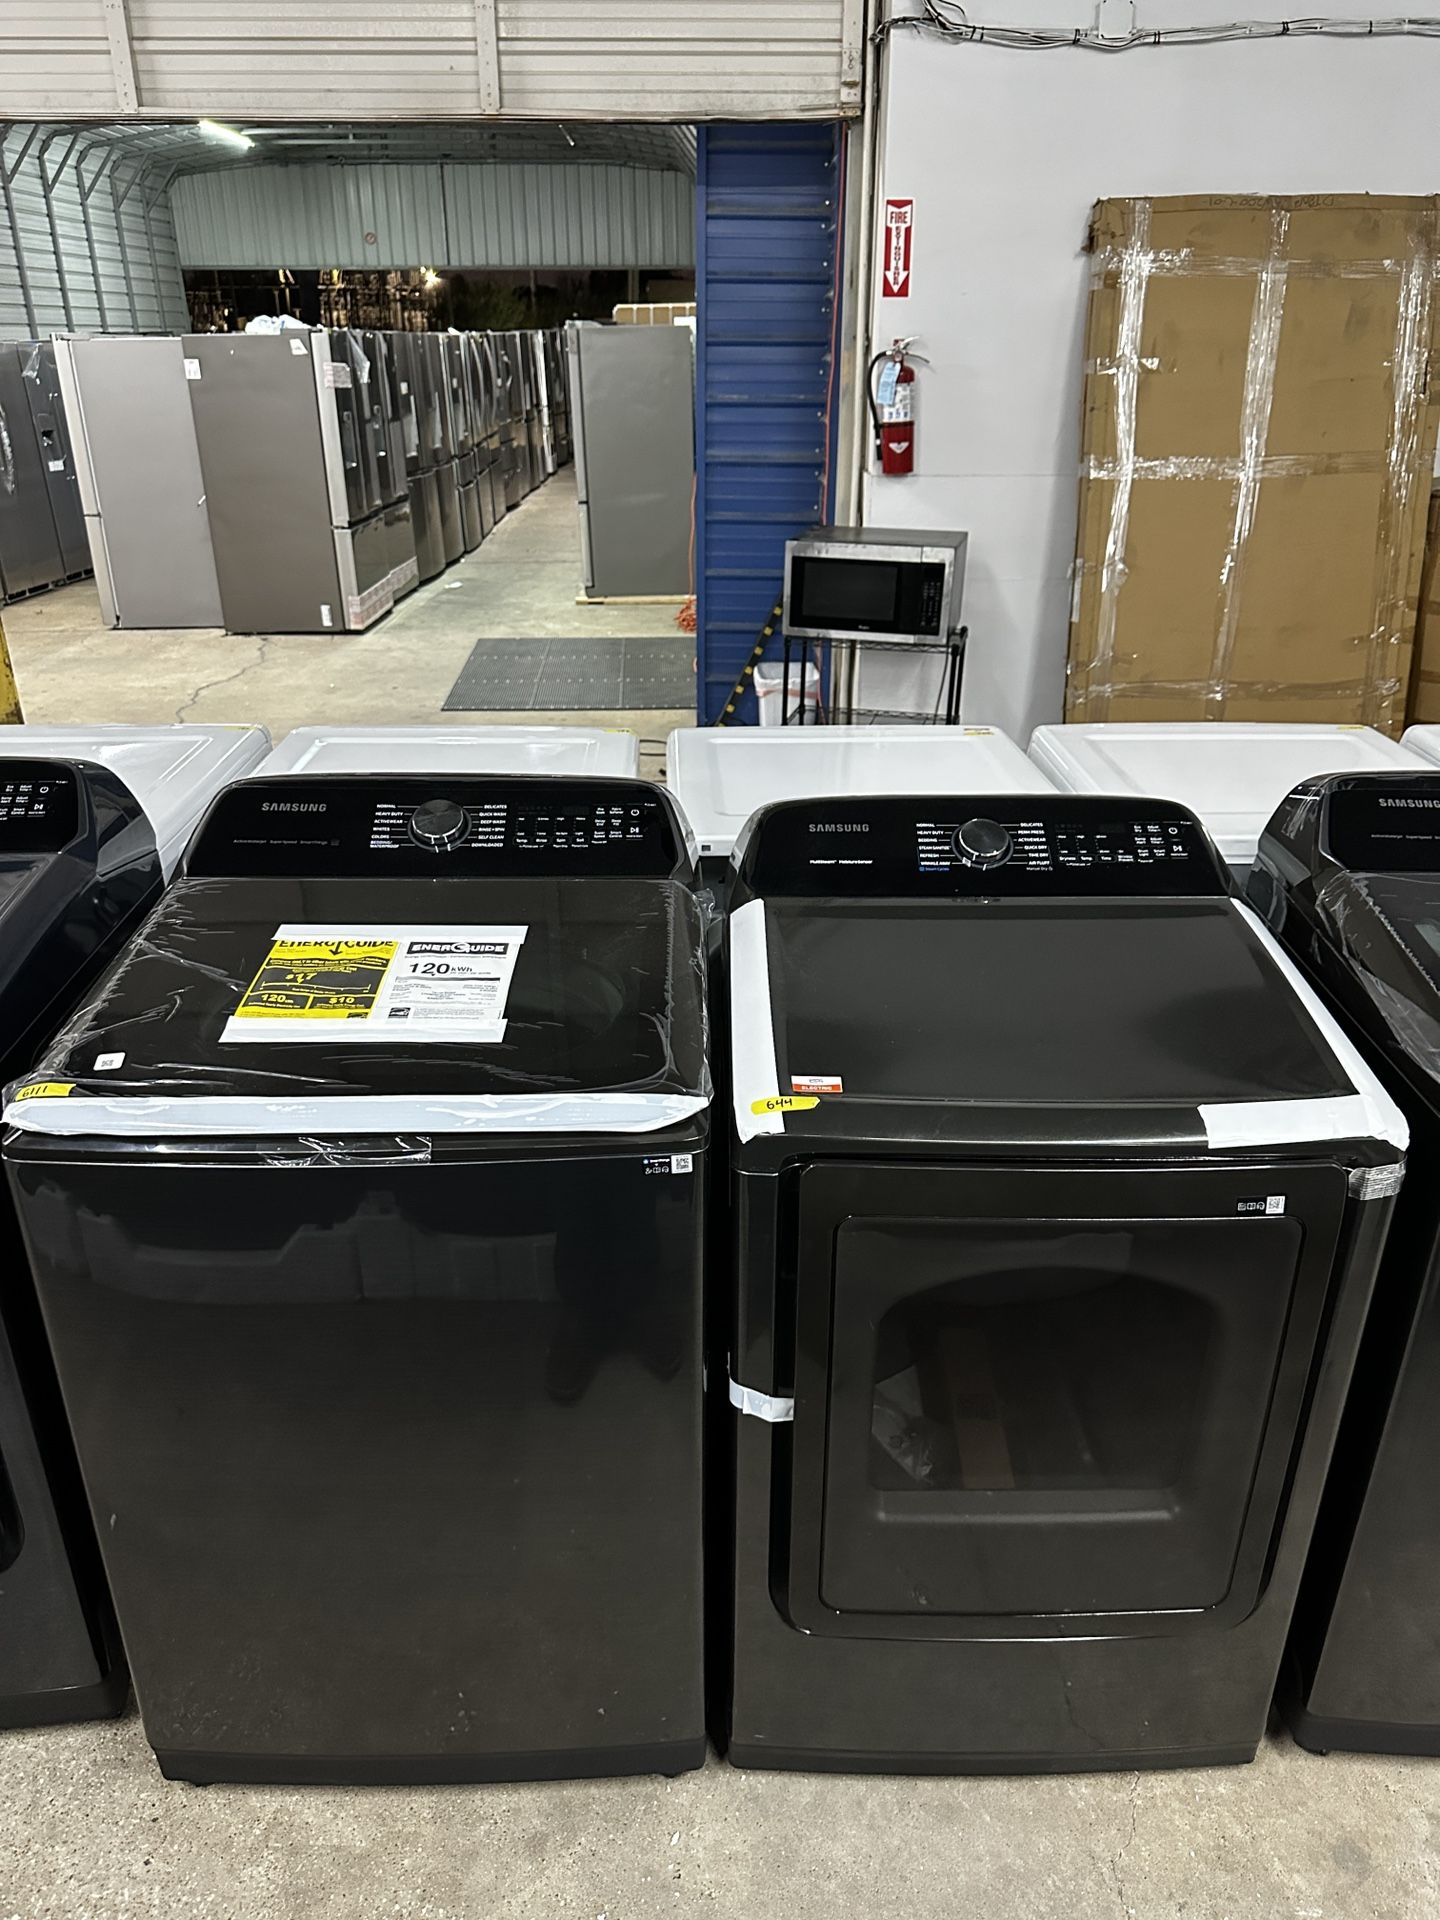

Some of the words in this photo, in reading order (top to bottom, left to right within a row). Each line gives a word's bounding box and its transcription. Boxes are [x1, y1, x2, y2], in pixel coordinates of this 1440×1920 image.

[890, 210, 908, 225] FIRE
[261, 802, 327, 812] SAMSUNG
[1378, 798, 1440, 808] SAMSUNG
[808, 823, 870, 832] SAMSUNG
[411, 942, 506, 954] ENERGUIDE
[409, 963, 451, 975] 120
[286, 972, 318, 981] $17
[261, 994, 287, 1003] 120
[766, 1097, 793, 1110] 644
